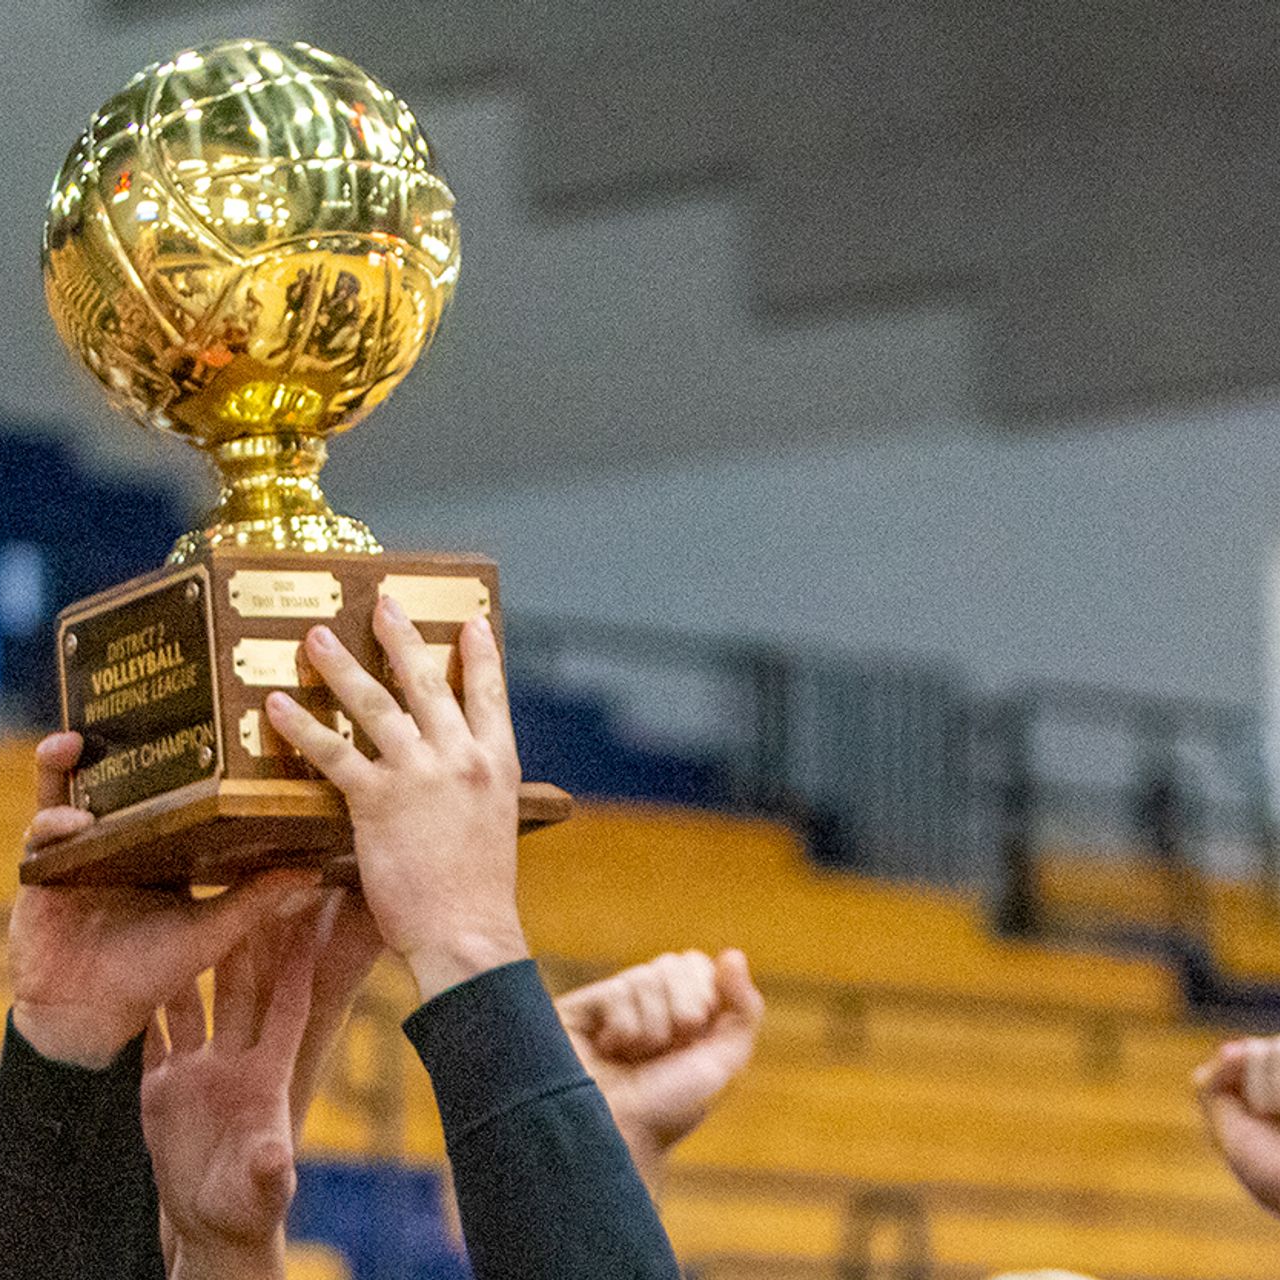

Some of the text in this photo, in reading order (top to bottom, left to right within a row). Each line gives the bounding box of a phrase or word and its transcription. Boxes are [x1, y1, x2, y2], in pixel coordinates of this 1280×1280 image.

[91, 640, 185, 697] VOLLEYBALL
[107, 625, 156, 664] DISTRICT
[76, 720, 216, 791] DISTRICT CHAMPION
